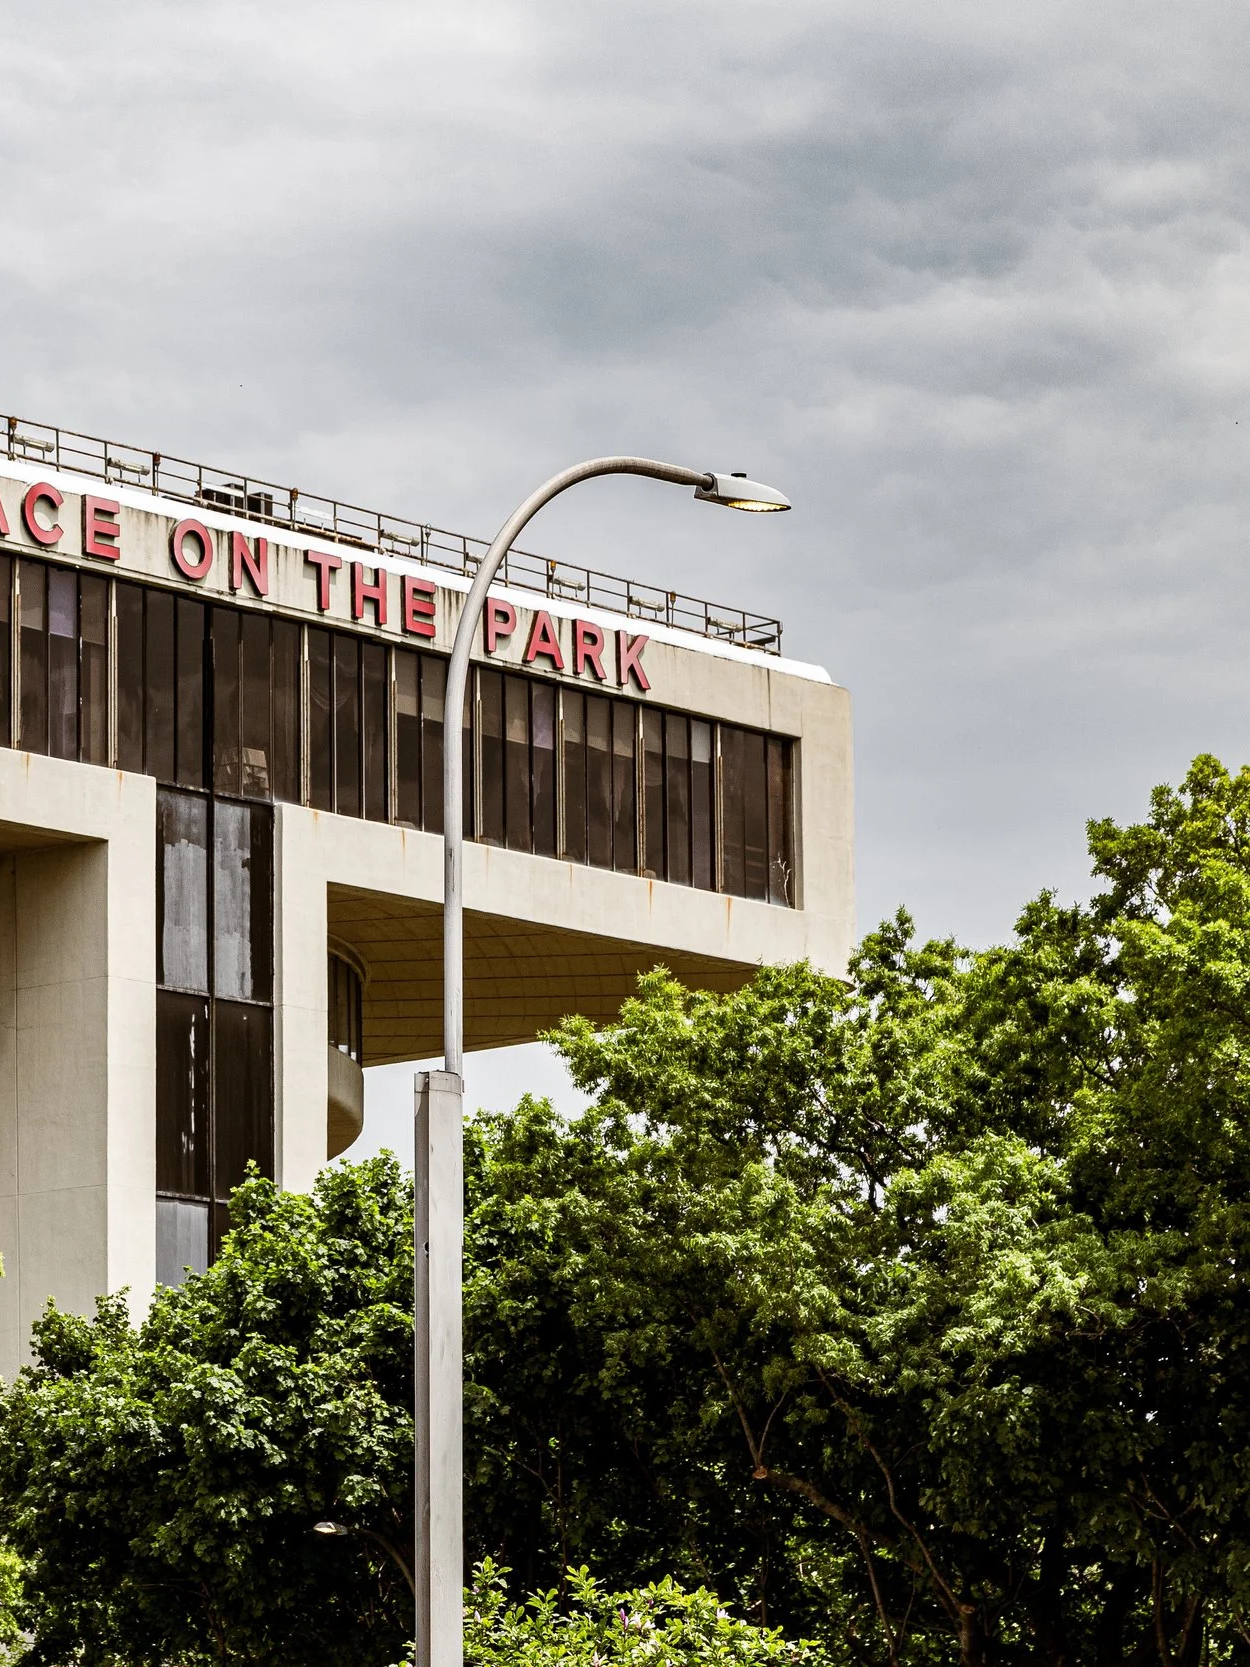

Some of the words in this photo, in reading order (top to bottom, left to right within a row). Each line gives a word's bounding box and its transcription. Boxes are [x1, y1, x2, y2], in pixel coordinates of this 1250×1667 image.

[172, 518, 268, 597] ON
[305, 549, 436, 637] THE
[484, 597, 652, 690] PARK
